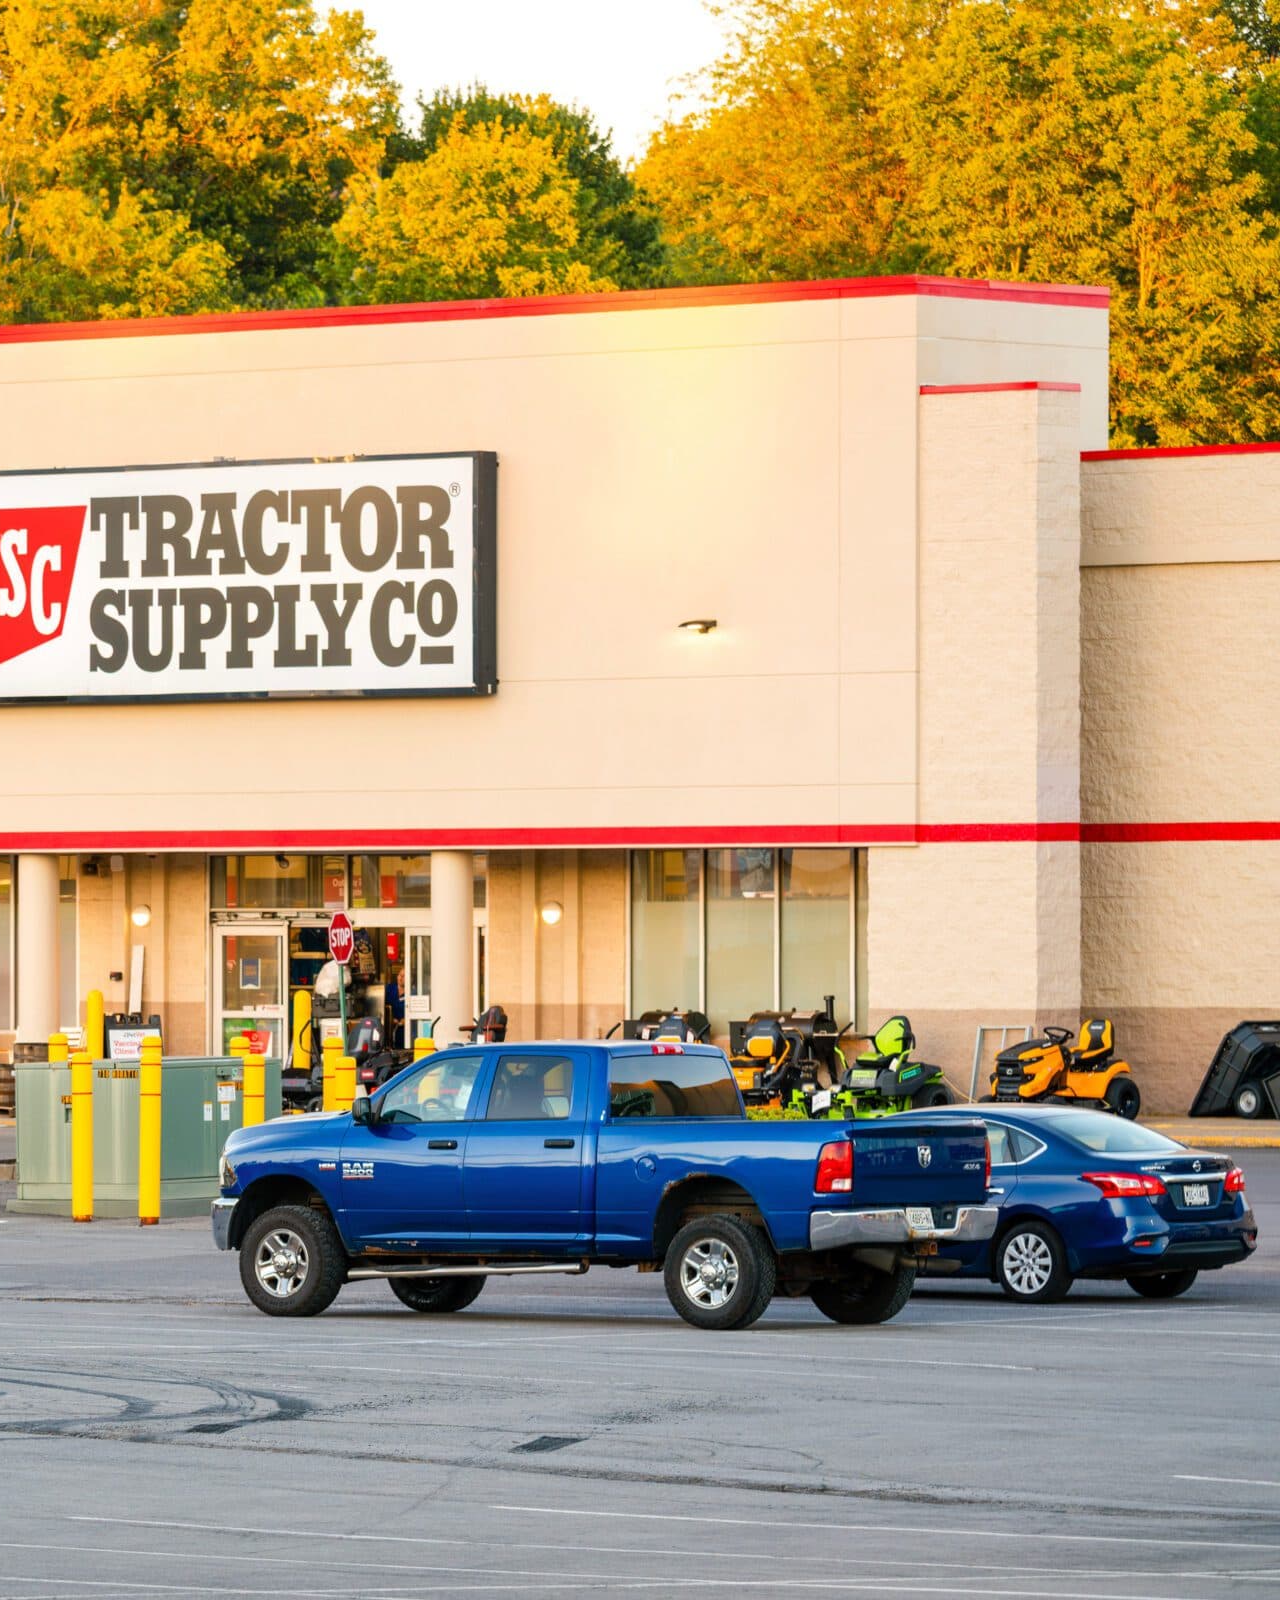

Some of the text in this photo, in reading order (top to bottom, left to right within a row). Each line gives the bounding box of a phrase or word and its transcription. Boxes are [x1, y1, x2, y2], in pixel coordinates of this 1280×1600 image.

[89, 484, 455, 579] TRACTOR
[89, 582, 364, 673] SUPPLY
[331, 927, 351, 949] STOP
[342, 1162, 375, 1170] RAM
